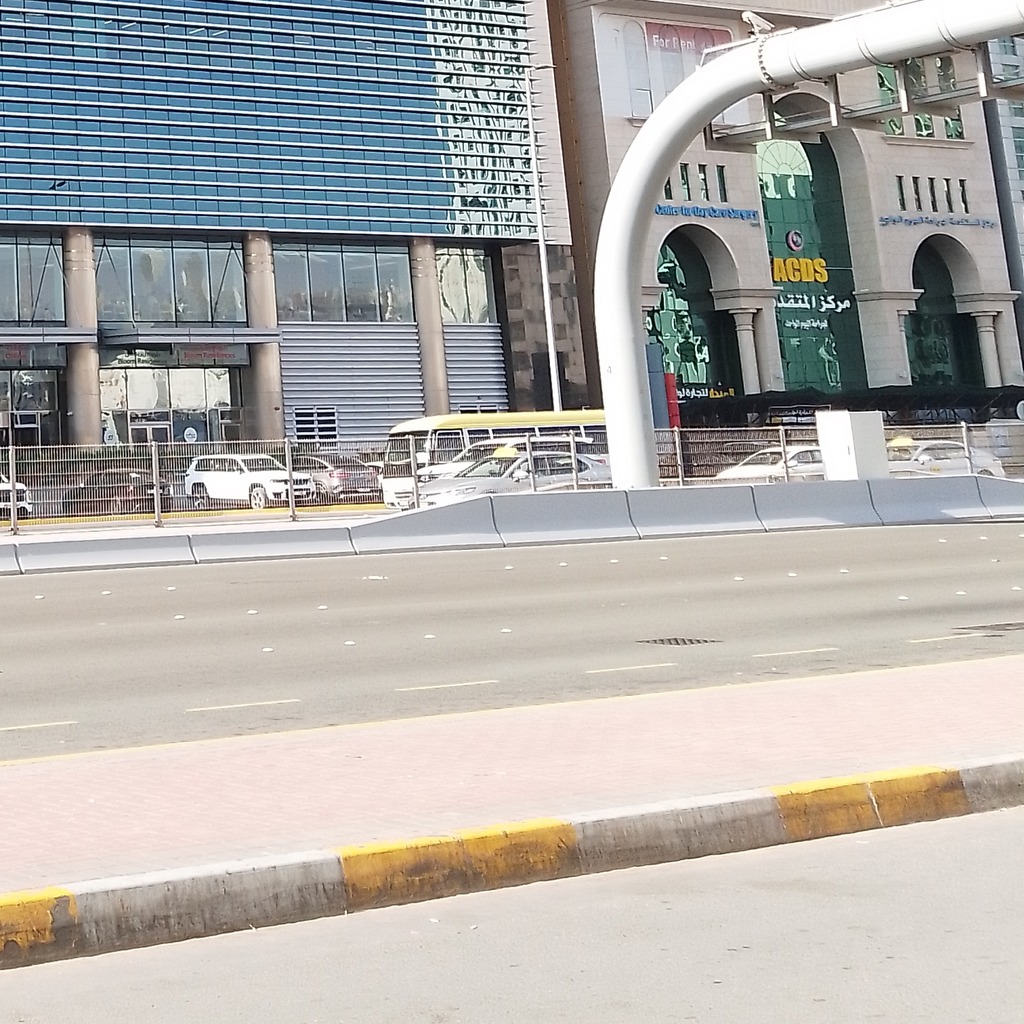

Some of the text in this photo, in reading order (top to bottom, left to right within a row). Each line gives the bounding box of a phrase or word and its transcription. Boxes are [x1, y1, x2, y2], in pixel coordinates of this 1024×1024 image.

[652, 34, 670, 49] For
[772, 257, 829, 283] ACDS
[777, 293, 851, 313] مركز المتقد
